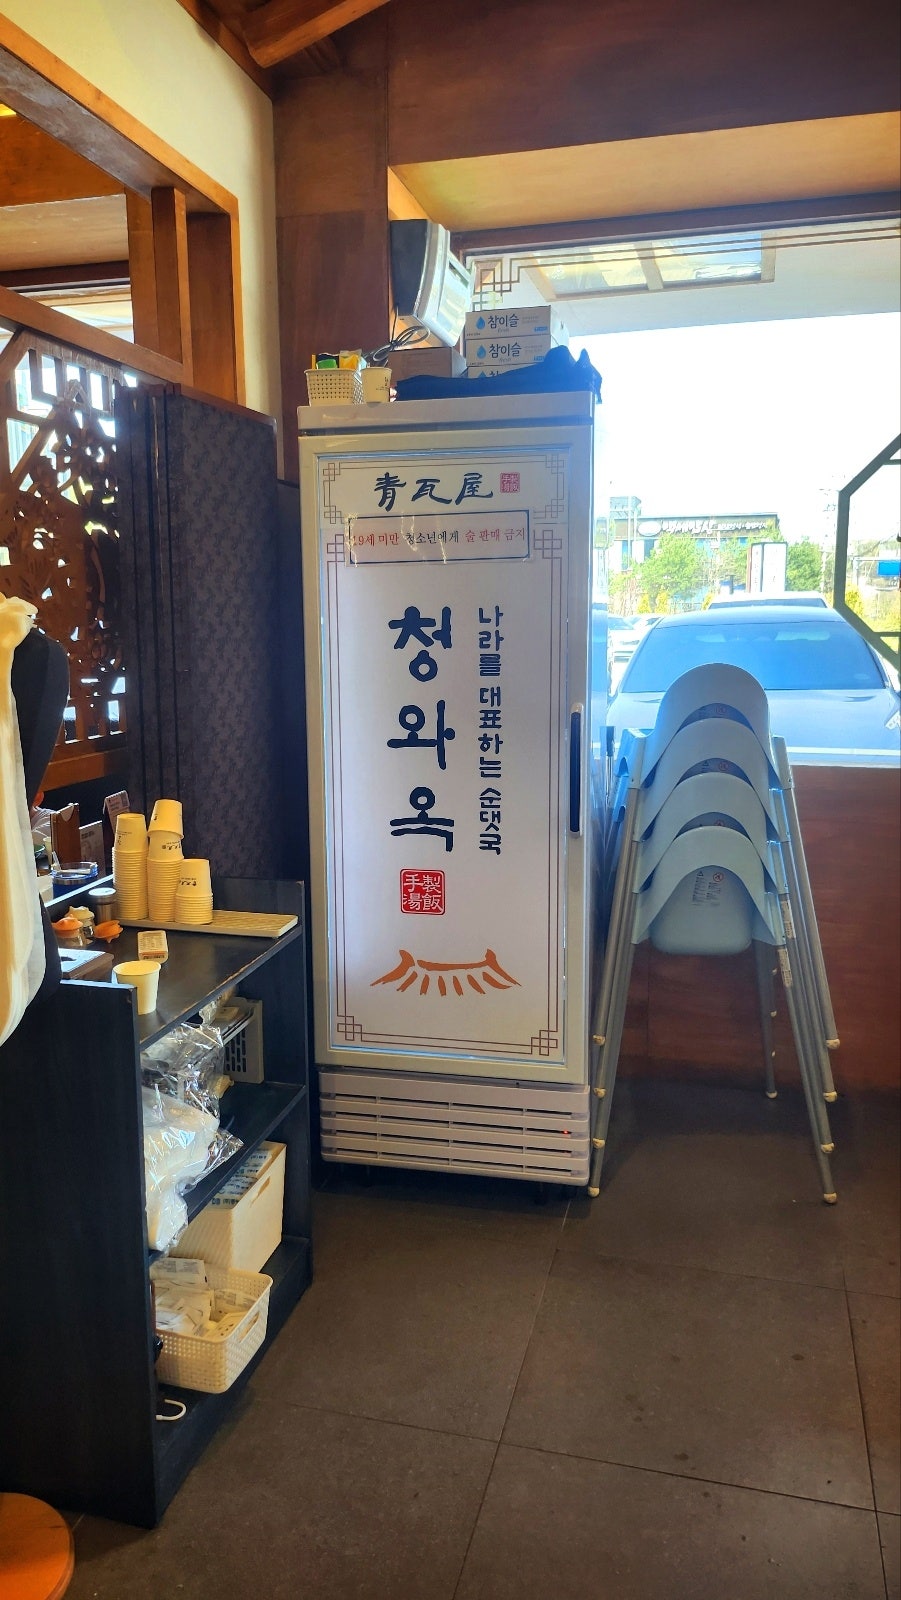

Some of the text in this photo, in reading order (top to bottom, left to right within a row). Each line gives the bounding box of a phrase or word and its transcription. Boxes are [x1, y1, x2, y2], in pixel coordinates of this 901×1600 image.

[488, 313, 519, 329] 참이슬
[489, 342, 522, 358] 참이슬
[353, 527, 525, 546] 19세 미만 청소년에게 술 판매 금지
[387, 606, 455, 852] 청와옥
[478, 605, 504, 855] 나라를 대표하는 순댓국
[404, 873, 441, 893] 手製
